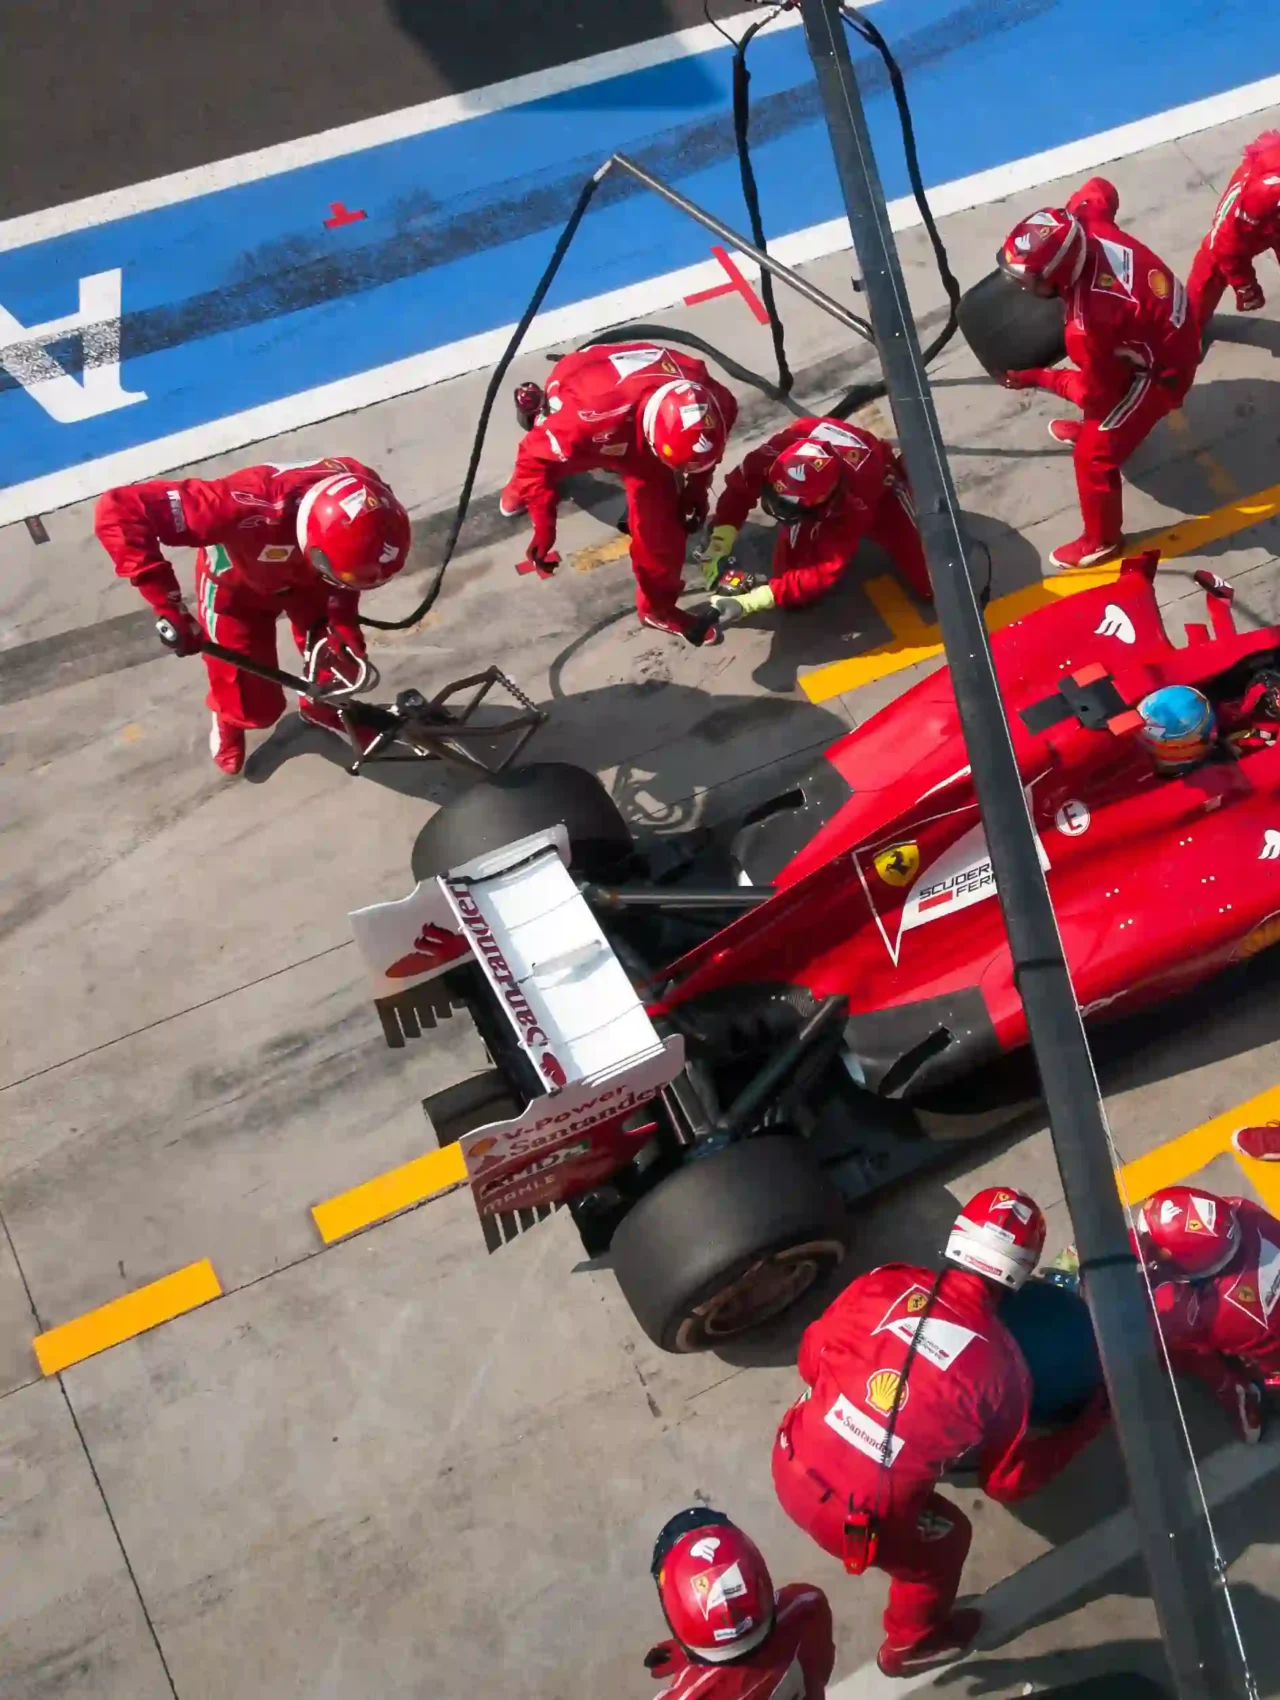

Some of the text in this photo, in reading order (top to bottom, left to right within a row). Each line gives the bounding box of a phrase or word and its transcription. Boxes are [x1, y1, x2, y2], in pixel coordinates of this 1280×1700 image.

[919, 862, 991, 899] SCUDER
[955, 873, 996, 898] FER
[450, 883, 549, 1047] Santander
[508, 1081, 668, 1156] Santander
